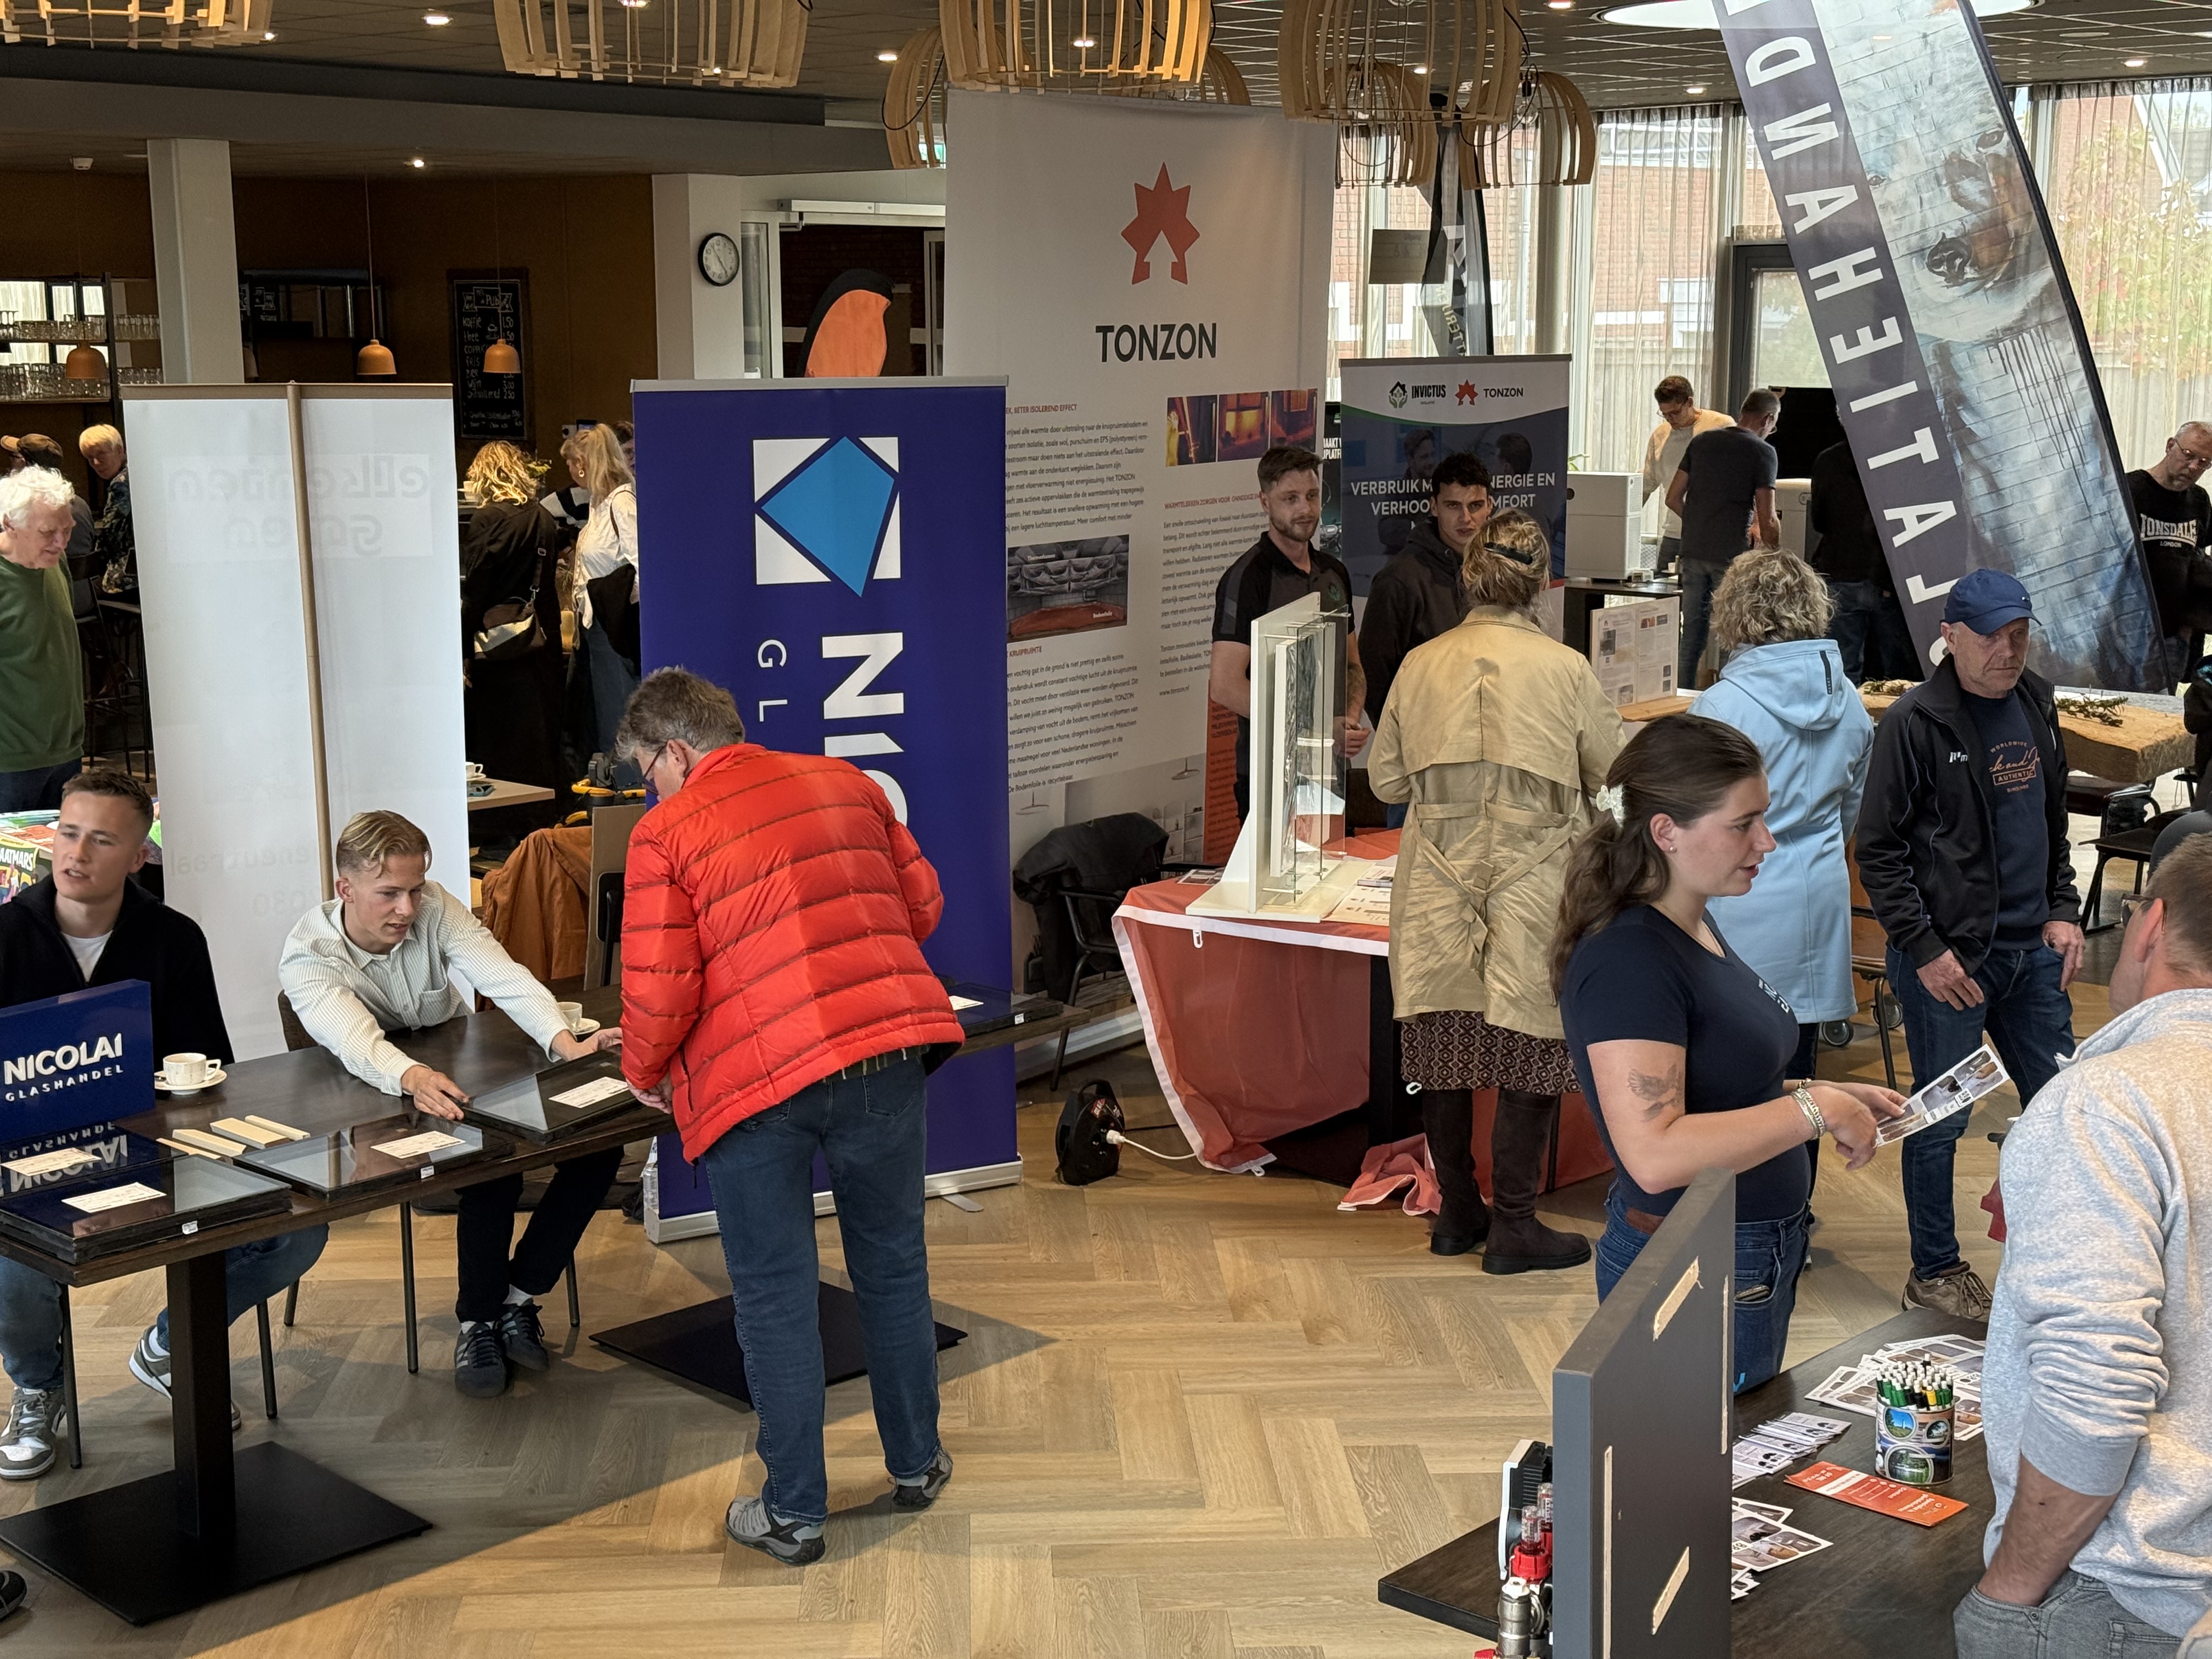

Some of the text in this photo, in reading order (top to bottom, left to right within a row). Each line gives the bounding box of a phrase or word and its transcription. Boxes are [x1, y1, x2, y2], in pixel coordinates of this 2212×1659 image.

[1096, 323, 1217, 363] TONZON
[1412, 385, 1446, 399] INVICTUS
[1483, 387, 1523, 398] TONZON
[1323, 438, 1338, 448] AAKT
[1351, 479, 1419, 495] VERBRUIK
[1488, 473, 1534, 489] NERGIE
[1537, 472, 1555, 487] EN
[1371, 493, 1536, 516] VERHOO MFORT
[1990, 741, 2028, 753] WORLDWIDE
[4, 1033, 122, 1085] NICOLAI
[5, 1065, 123, 1102] GLASHANDEL
